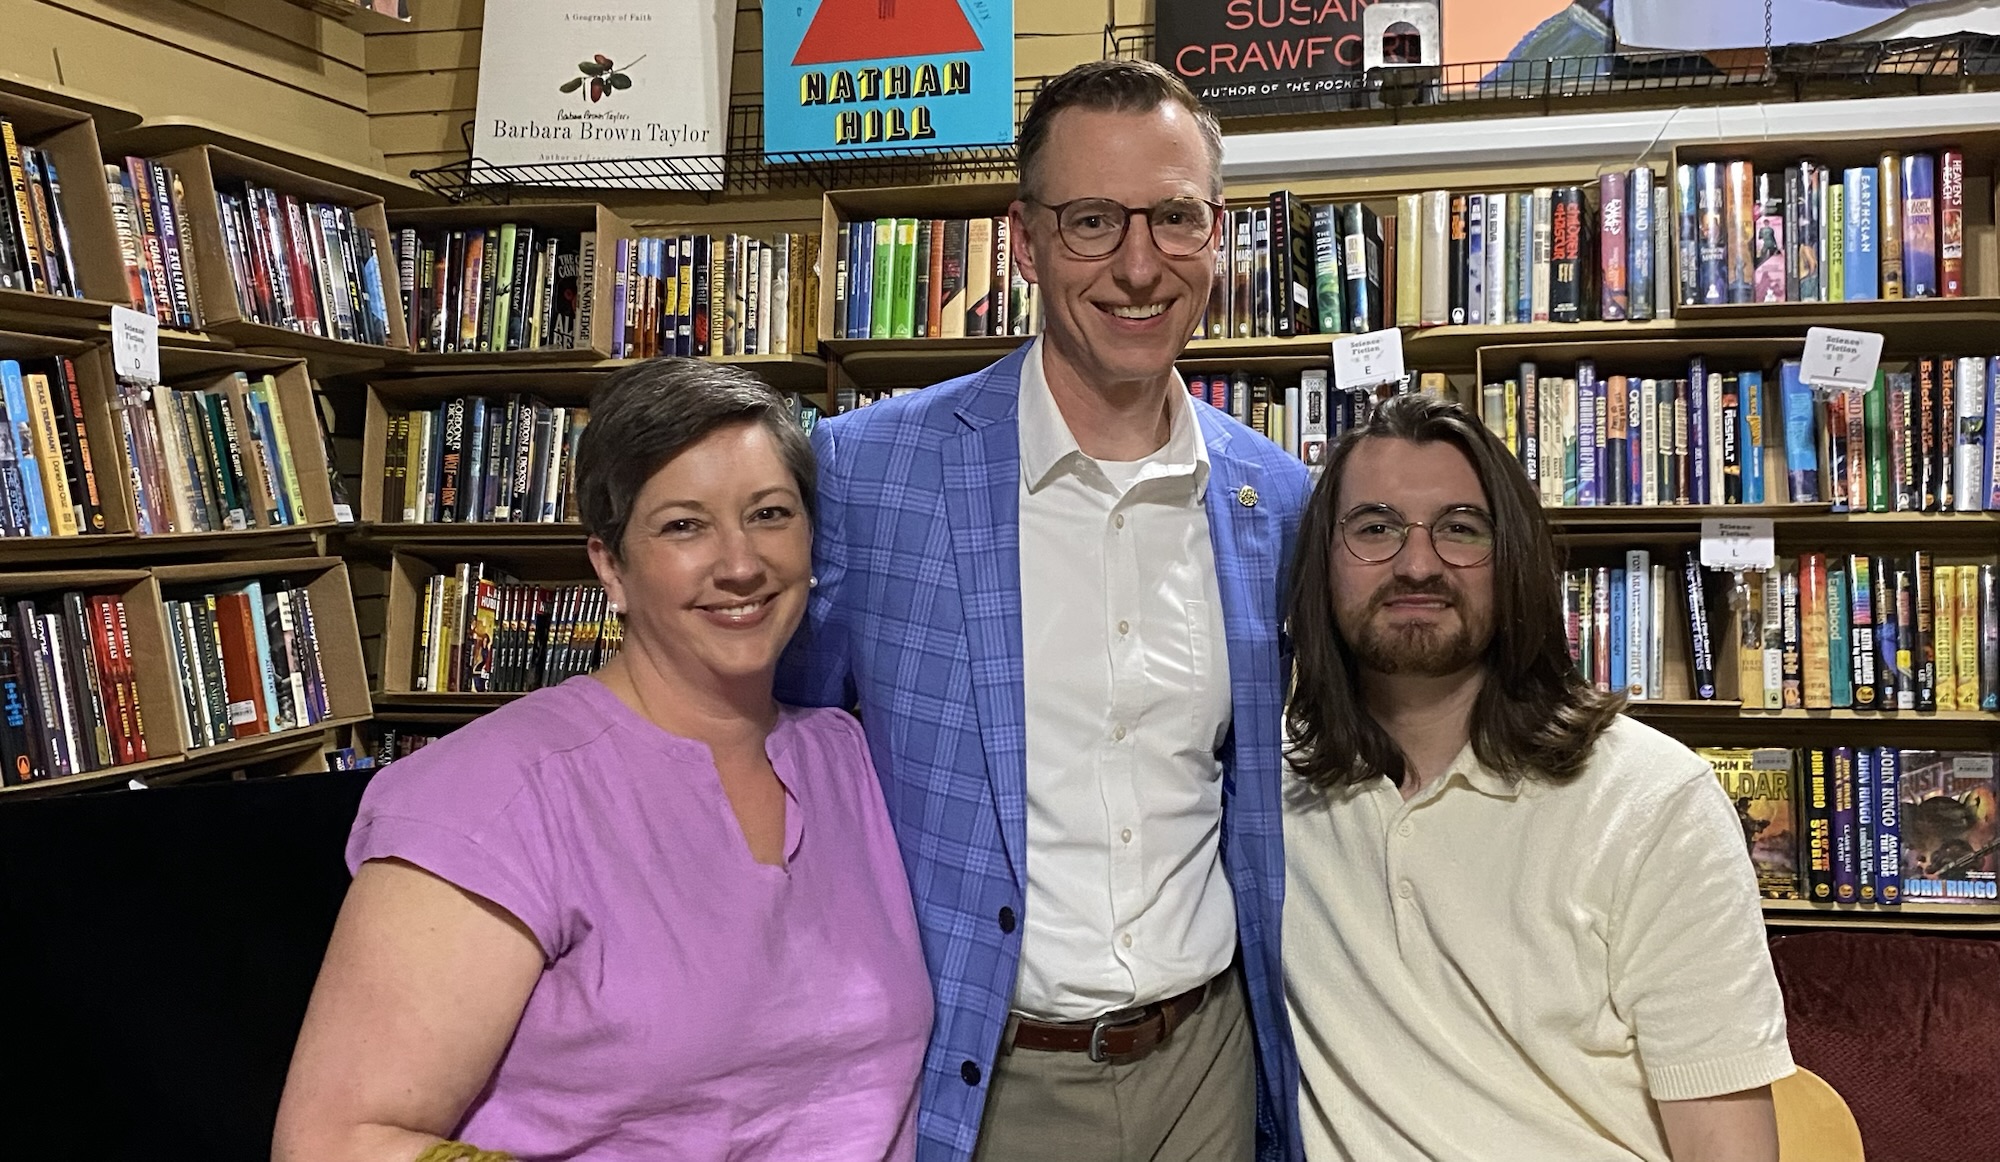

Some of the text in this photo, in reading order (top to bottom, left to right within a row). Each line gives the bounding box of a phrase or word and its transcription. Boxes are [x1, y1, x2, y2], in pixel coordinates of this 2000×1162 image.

[572, 13, 615, 23] Geography
[619, 13, 627, 21] of
[630, 13, 652, 21] Faith
[1225, 0, 1380, 30] SUSAN
[801, 60, 971, 106] NATHAN
[1202, 85, 1256, 98] AUTHOR
[1261, 83, 1278, 95] OF
[1286, 80, 1311, 92] THE
[493, 119, 710, 147] Barbara Brown Taylor
[834, 105, 936, 145] HILL
[1952, 160, 1962, 205] HEAVEN'S
[160, 204, 175, 237] BAXTER
[1860, 175, 1870, 253] EARTHCLAN
[110, 203, 141, 268] CHARISMA
[997, 221, 1005, 250] ABLE
[145, 237, 172, 305] COALESCENT
[165, 246, 191, 309] EXULTANT
[712, 259, 726, 293] DOCTOR
[996, 252, 1005, 276] ONE
[579, 283, 593, 340] KNOWLEDGE
[124, 323, 146, 336] Science
[125, 332, 145, 344] Fiction
[1351, 338, 1381, 349] Science
[1826, 335, 1861, 346] Science
[134, 358, 141, 370] D
[1352, 345, 1381, 356] Fiction
[1826, 343, 1858, 354] Fiction
[1365, 365, 1372, 375] E
[1833, 366, 1842, 377] F
[1920, 360, 1932, 411] Exiled:
[1942, 360, 1953, 409] Exiled:
[35, 379, 47, 406] TEXAS
[1629, 389, 1640, 427] OMEGA
[40, 406, 57, 455] TRIUMPHANT
[445, 404, 455, 446] DICKSON
[453, 399, 464, 440] GORDON
[1725, 409, 1735, 462] ASSAULT
[1526, 437, 1536, 459] GREG
[518, 457, 528, 493] DICKSON
[1719, 522, 1753, 531] Science
[1720, 530, 1750, 538] Fiction
[1732, 549, 1739, 557] L
[302, 589, 313, 616] Fred
[1766, 577, 1779, 626] MAINSPRING
[1829, 577, 1841, 640] Earthblood
[307, 616, 320, 651] Hoyle
[1860, 628, 1873, 651] KEITH
[1861, 652, 1874, 685] LAUMER
[33, 649, 54, 729] WARHAVEN
[1811, 750, 1826, 809] JOHN RINGO
[1857, 752, 1871, 824] JOHN RINGO
[1881, 751, 1895, 827] JOHN RINGO
[1810, 819, 1822, 871] STORM
[1880, 833, 1889, 877] THE TIDE
[1889, 834, 1898, 876] AGAINST
[1903, 878, 1998, 899] JOHN RINGO
